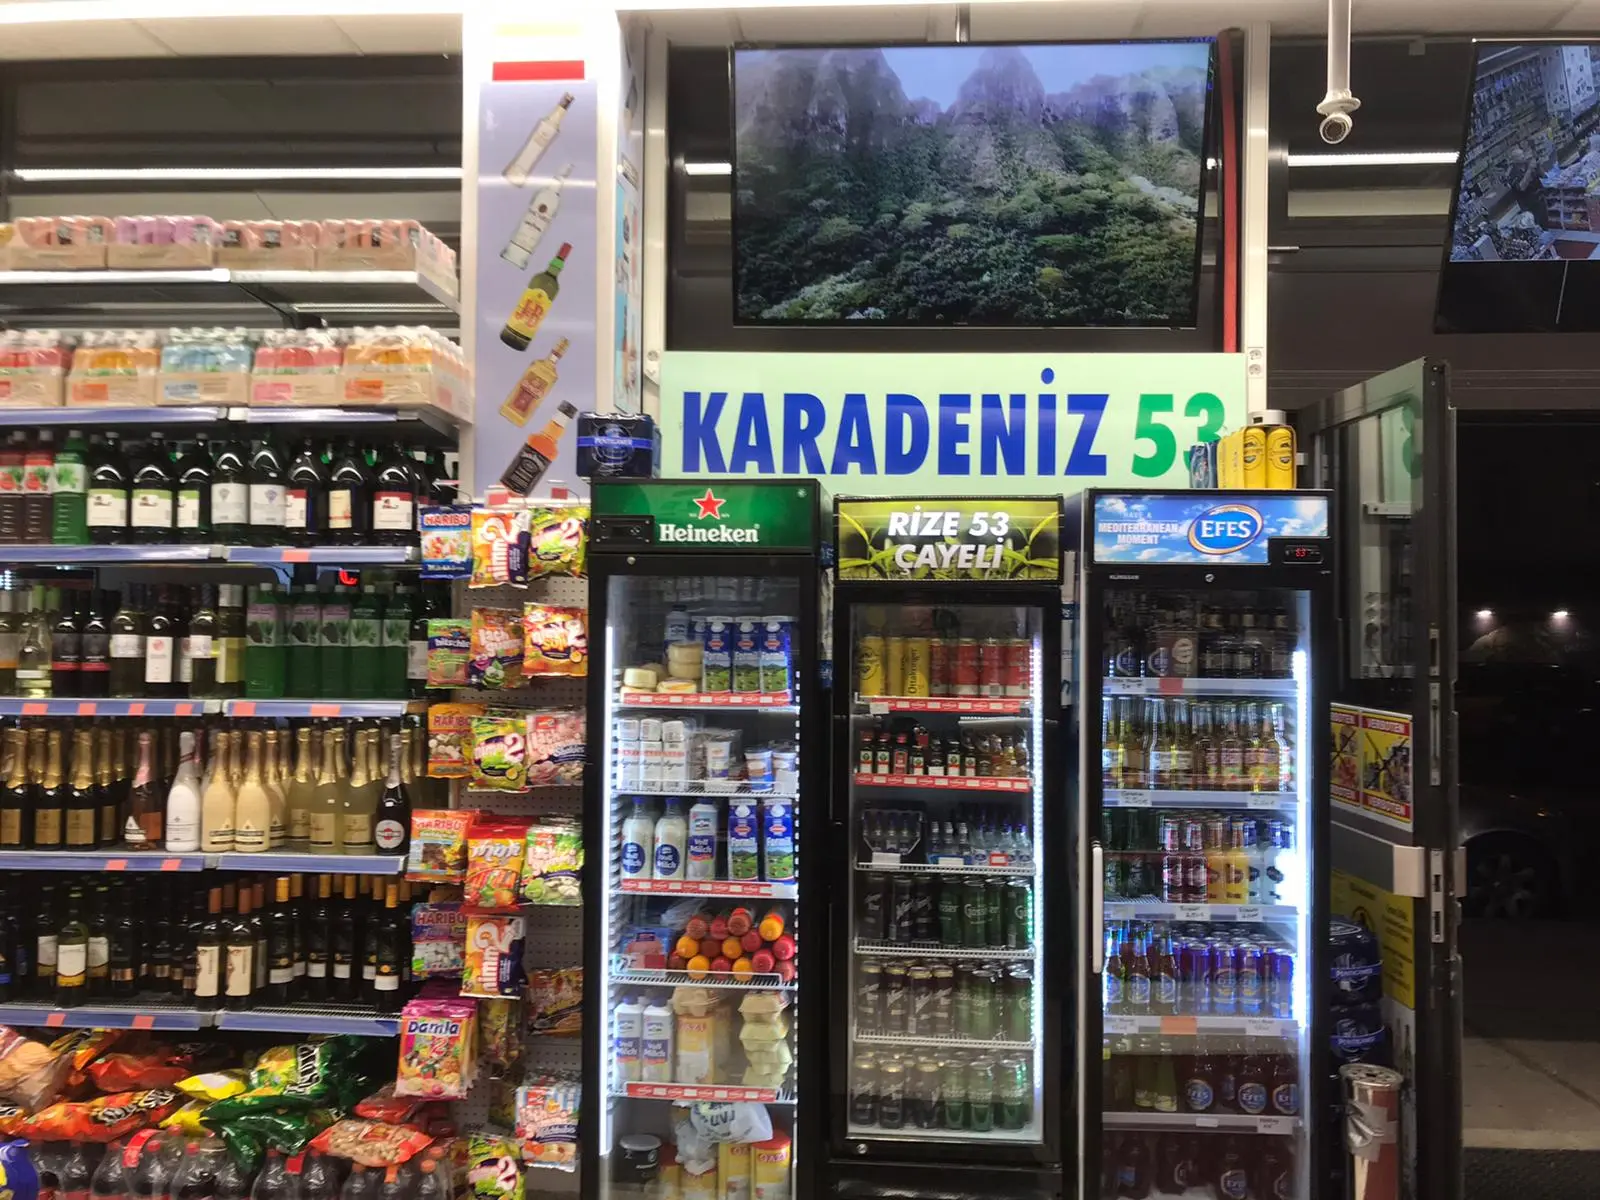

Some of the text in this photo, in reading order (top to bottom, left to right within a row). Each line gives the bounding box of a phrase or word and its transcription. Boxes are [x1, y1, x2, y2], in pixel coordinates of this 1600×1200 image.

[682, 367, 1226, 479] KARADENİZ 53
[423, 513, 470, 526] HARIBO
[888, 504, 1010, 537] RİZE 53
[1098, 522, 1180, 534] MEDITERRANEAN
[1201, 518, 1252, 538] EFES
[659, 523, 760, 543] Heineken
[1117, 534, 1160, 545] MOMENT
[894, 537, 1005, 576] ÇAYELİ
[415, 911, 465, 926] HARIBO
[407, 1020, 460, 1036] Damla
